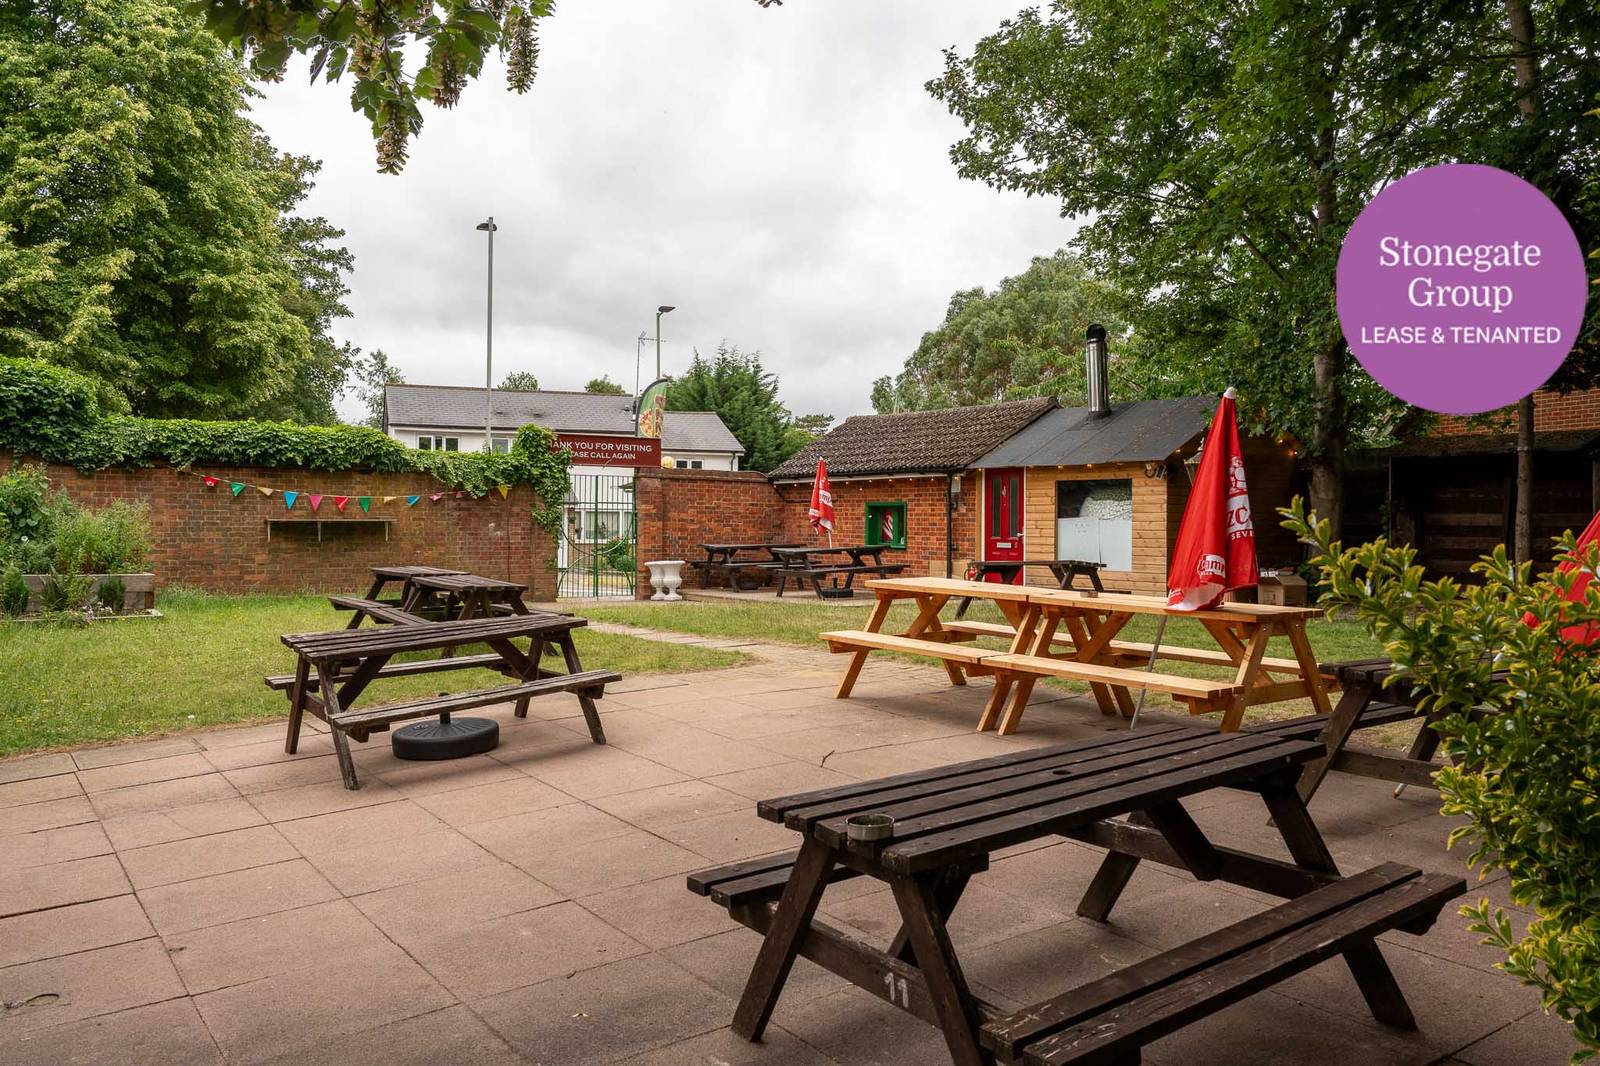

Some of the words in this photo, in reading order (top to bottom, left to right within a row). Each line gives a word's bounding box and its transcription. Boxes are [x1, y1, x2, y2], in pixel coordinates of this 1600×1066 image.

[575, 441, 594, 450] YOU
[595, 442, 614, 451] FOR
[616, 443, 653, 452] VISITING
[590, 451, 611, 459] CALL
[611, 452, 636, 460] AGAIN
[884, 972, 909, 1009] 11
